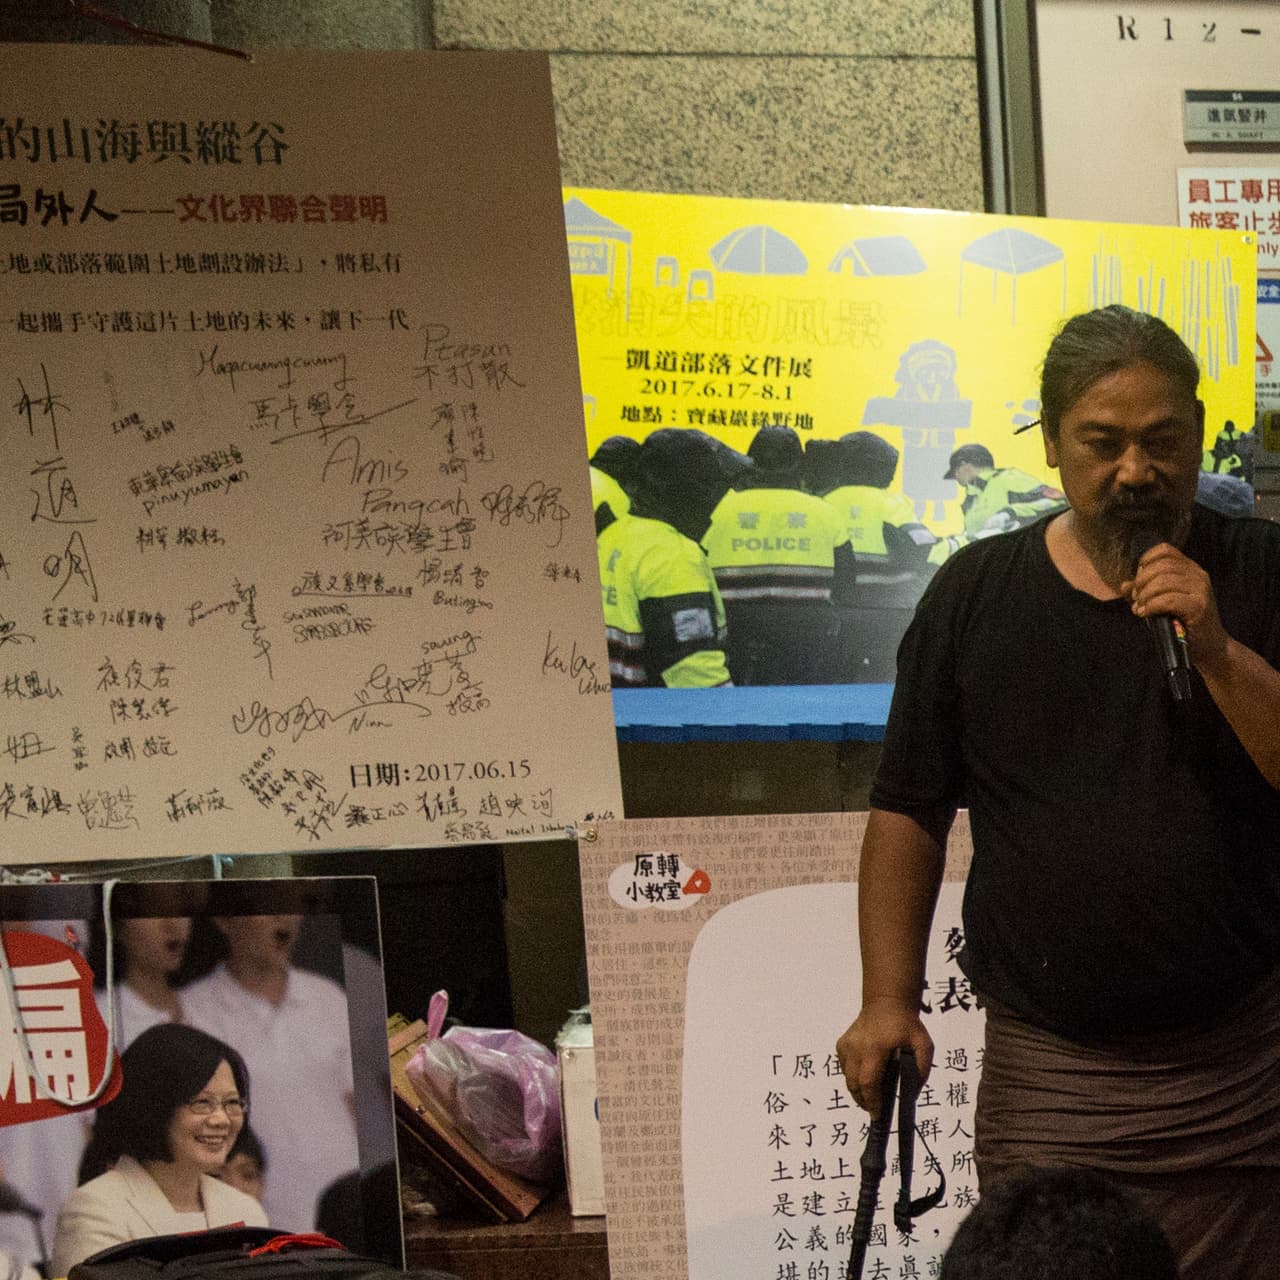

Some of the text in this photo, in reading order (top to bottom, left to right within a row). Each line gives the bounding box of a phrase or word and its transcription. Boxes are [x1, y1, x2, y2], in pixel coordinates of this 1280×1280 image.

[640, 378, 794, 401] 2017.6.17-8.1
[321, 434, 409, 486] Amis
[731, 536, 811, 552] POLICE
[632, 853, 681, 878] 原轉
[625, 880, 682, 903] 小教室
